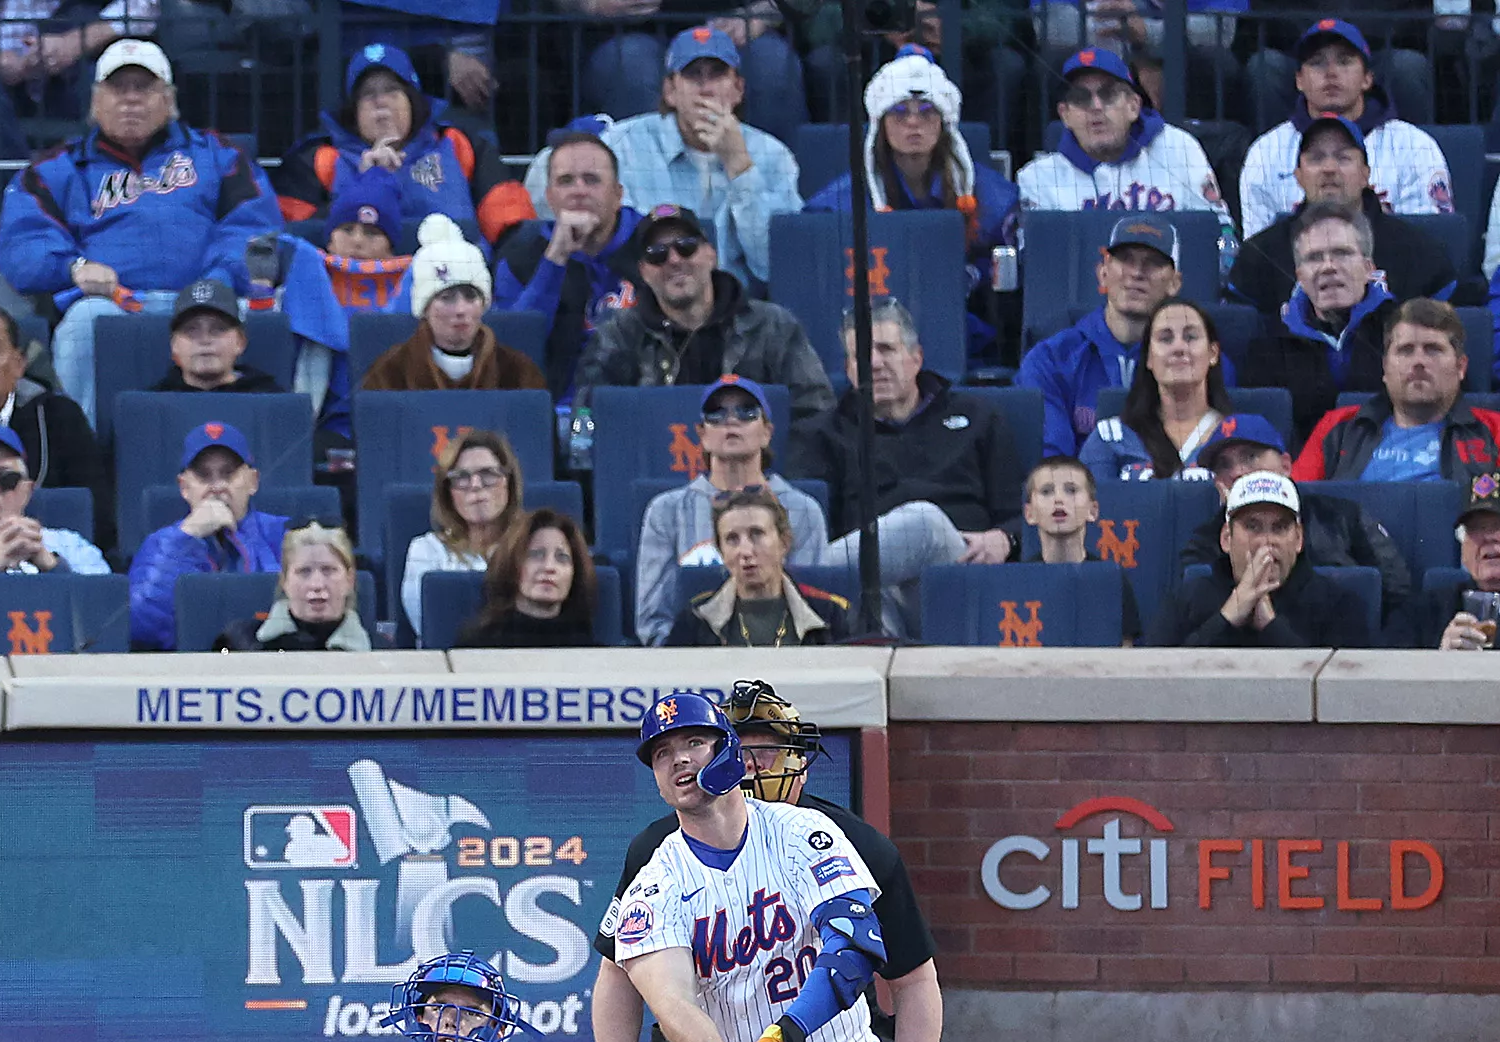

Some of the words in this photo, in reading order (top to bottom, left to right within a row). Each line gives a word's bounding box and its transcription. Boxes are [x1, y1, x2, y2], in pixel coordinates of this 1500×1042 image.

[91, 151, 198, 220] Mets
[136, 686, 725, 724] METS.COM/MEMBERS
[456, 836, 588, 866] 2024
[810, 832, 833, 850] 24
[980, 818, 1169, 912] citi
[1198, 838, 1445, 911] FIELD
[244, 874, 592, 985] NLCS
[692, 887, 797, 978] Mets
[764, 945, 818, 1005] 20
[323, 994, 583, 1038] loaot
